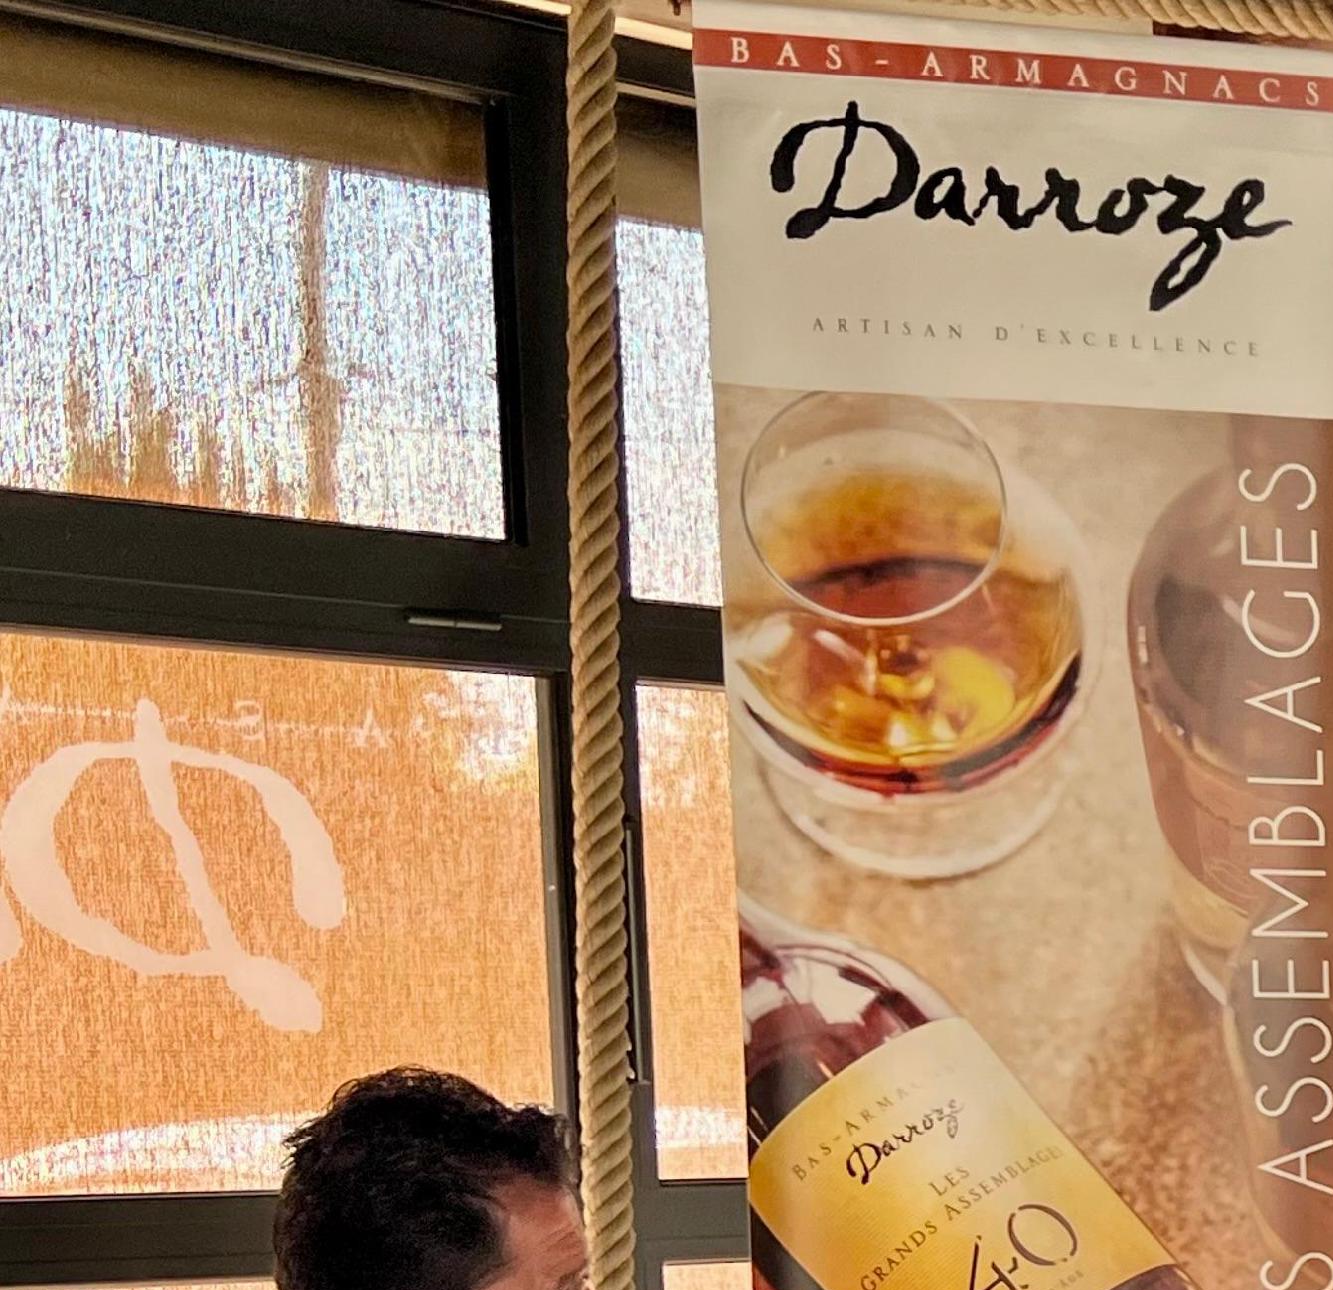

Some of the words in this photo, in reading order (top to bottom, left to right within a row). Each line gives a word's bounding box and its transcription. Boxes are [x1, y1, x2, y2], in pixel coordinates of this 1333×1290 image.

[730, 37, 1323, 106] BAS-ARMAGNACS
[769, 100, 1294, 312] Darroze
[811, 316, 966, 342] ARTISAN
[995, 322, 1262, 357] D'EXCELLENCE
[846, 1098, 965, 1185] Darroze
[928, 1166, 970, 1196] LES
